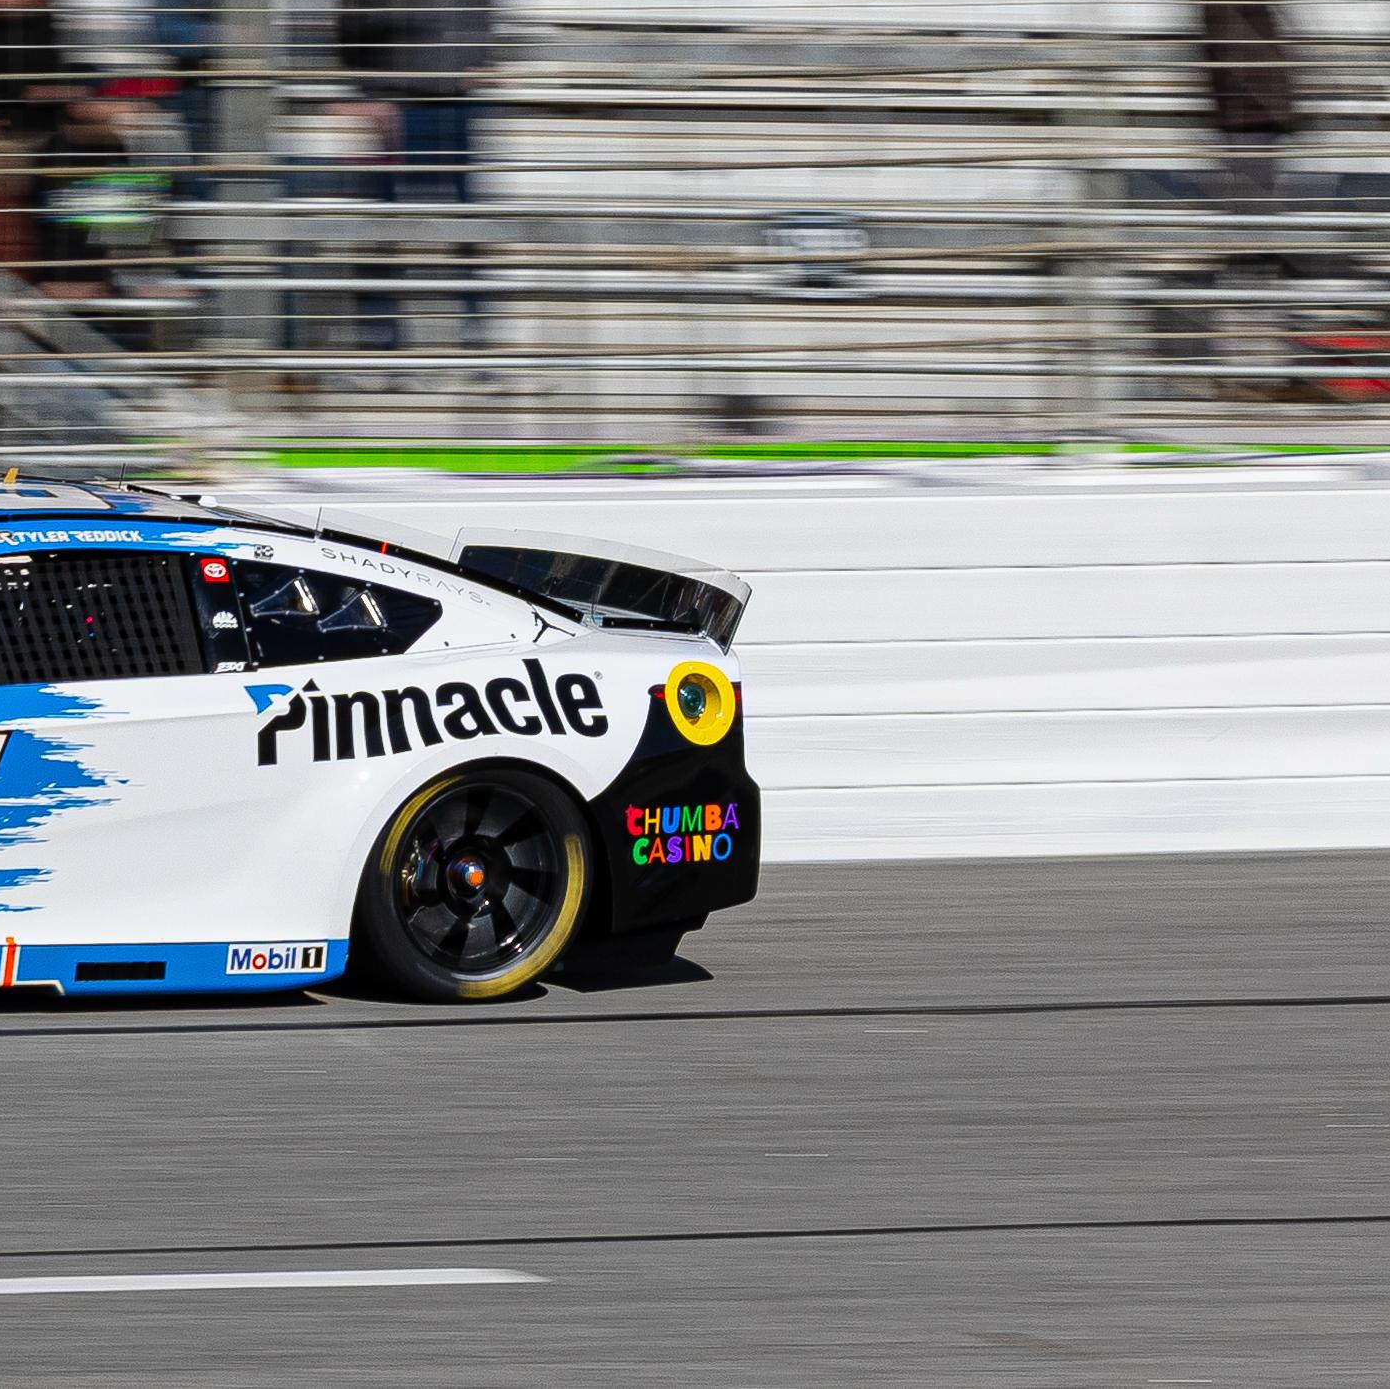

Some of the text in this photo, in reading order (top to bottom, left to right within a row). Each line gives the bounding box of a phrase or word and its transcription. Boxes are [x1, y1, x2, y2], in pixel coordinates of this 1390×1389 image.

[15, 530, 71, 543] TYLER
[69, 530, 144, 543] REDDICK
[243, 658, 610, 767] Pinnacle
[625, 803, 739, 836] CHUMBA
[632, 833, 733, 865] CASINO
[230, 947, 297, 970] Mobil
